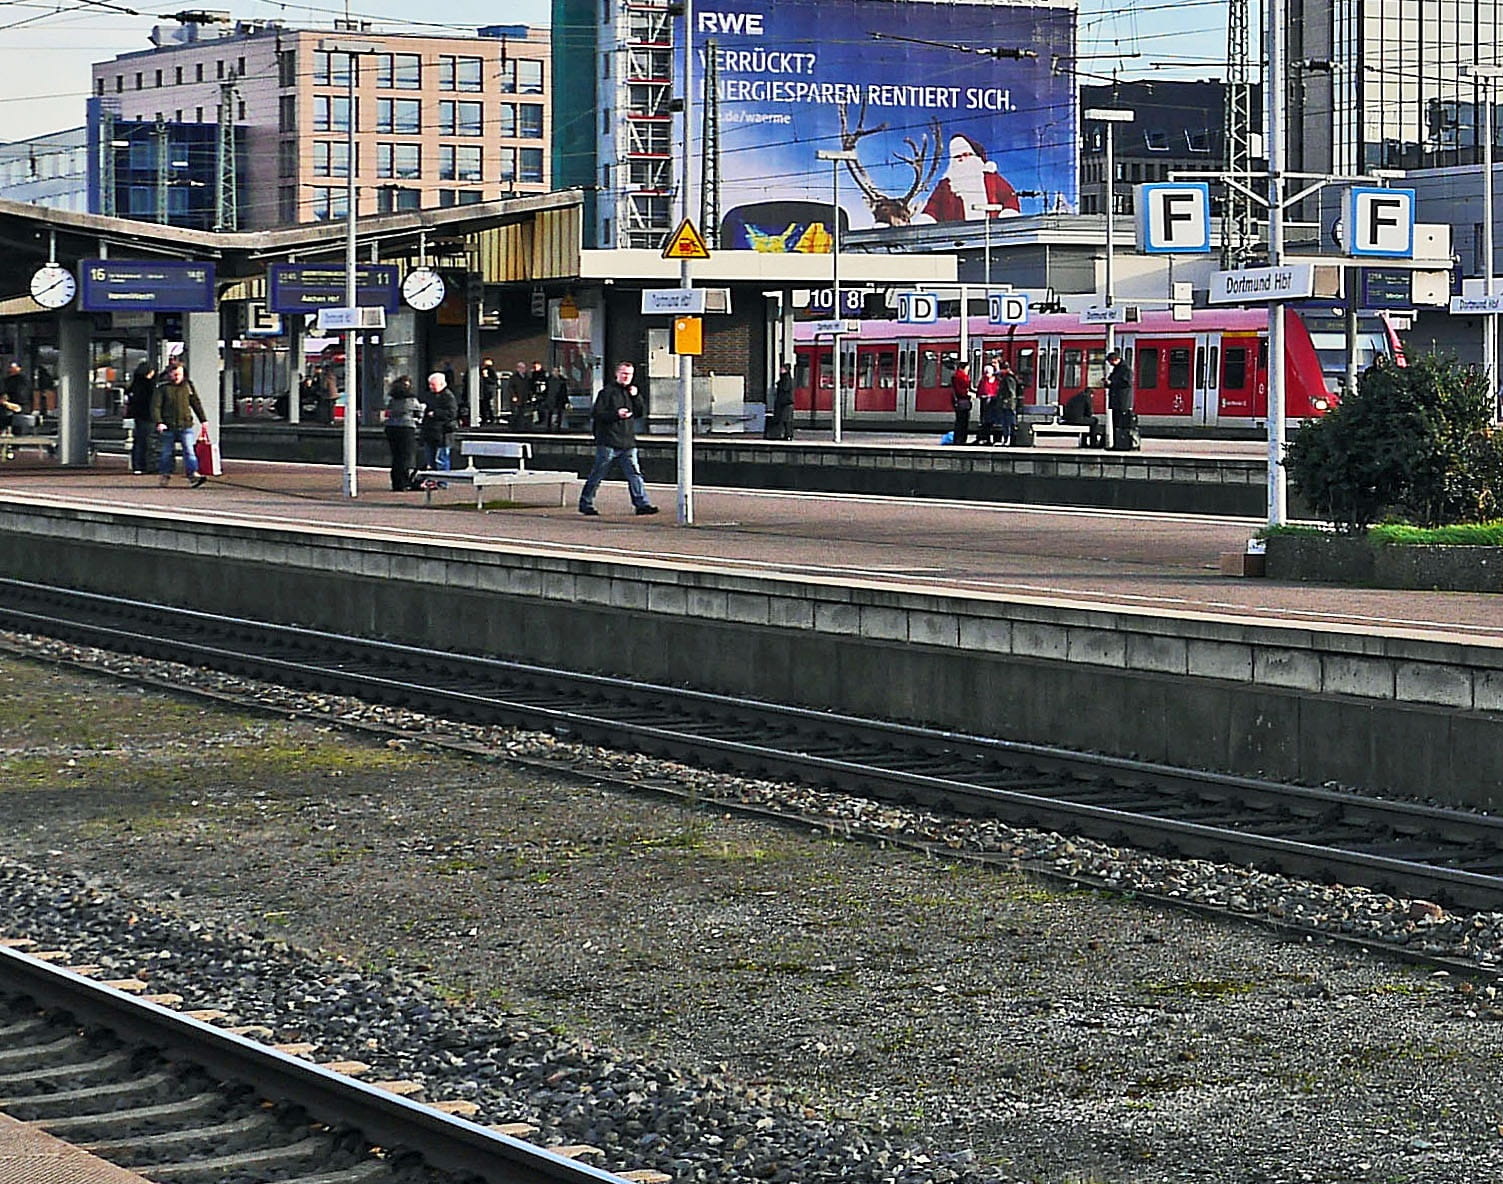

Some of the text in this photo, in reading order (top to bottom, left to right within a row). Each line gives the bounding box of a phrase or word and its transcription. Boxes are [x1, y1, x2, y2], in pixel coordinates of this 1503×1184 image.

[698, 12, 764, 35] RWE
[700, 79, 1017, 112] NERGIESPAREN RENTIERT SICH.
[701, 110, 792, 125] .de/waerme
[1162, 193, 1194, 242] F
[1369, 198, 1401, 245] F
[90, 268, 106, 281] 16
[1226, 273, 1293, 295] Dortmund Hbf
[810, 289, 833, 308] 10
[847, 290, 859, 309] 8
[915, 298, 931, 318] D
[254, 305, 273, 329] E
[1007, 300, 1023, 320] D
